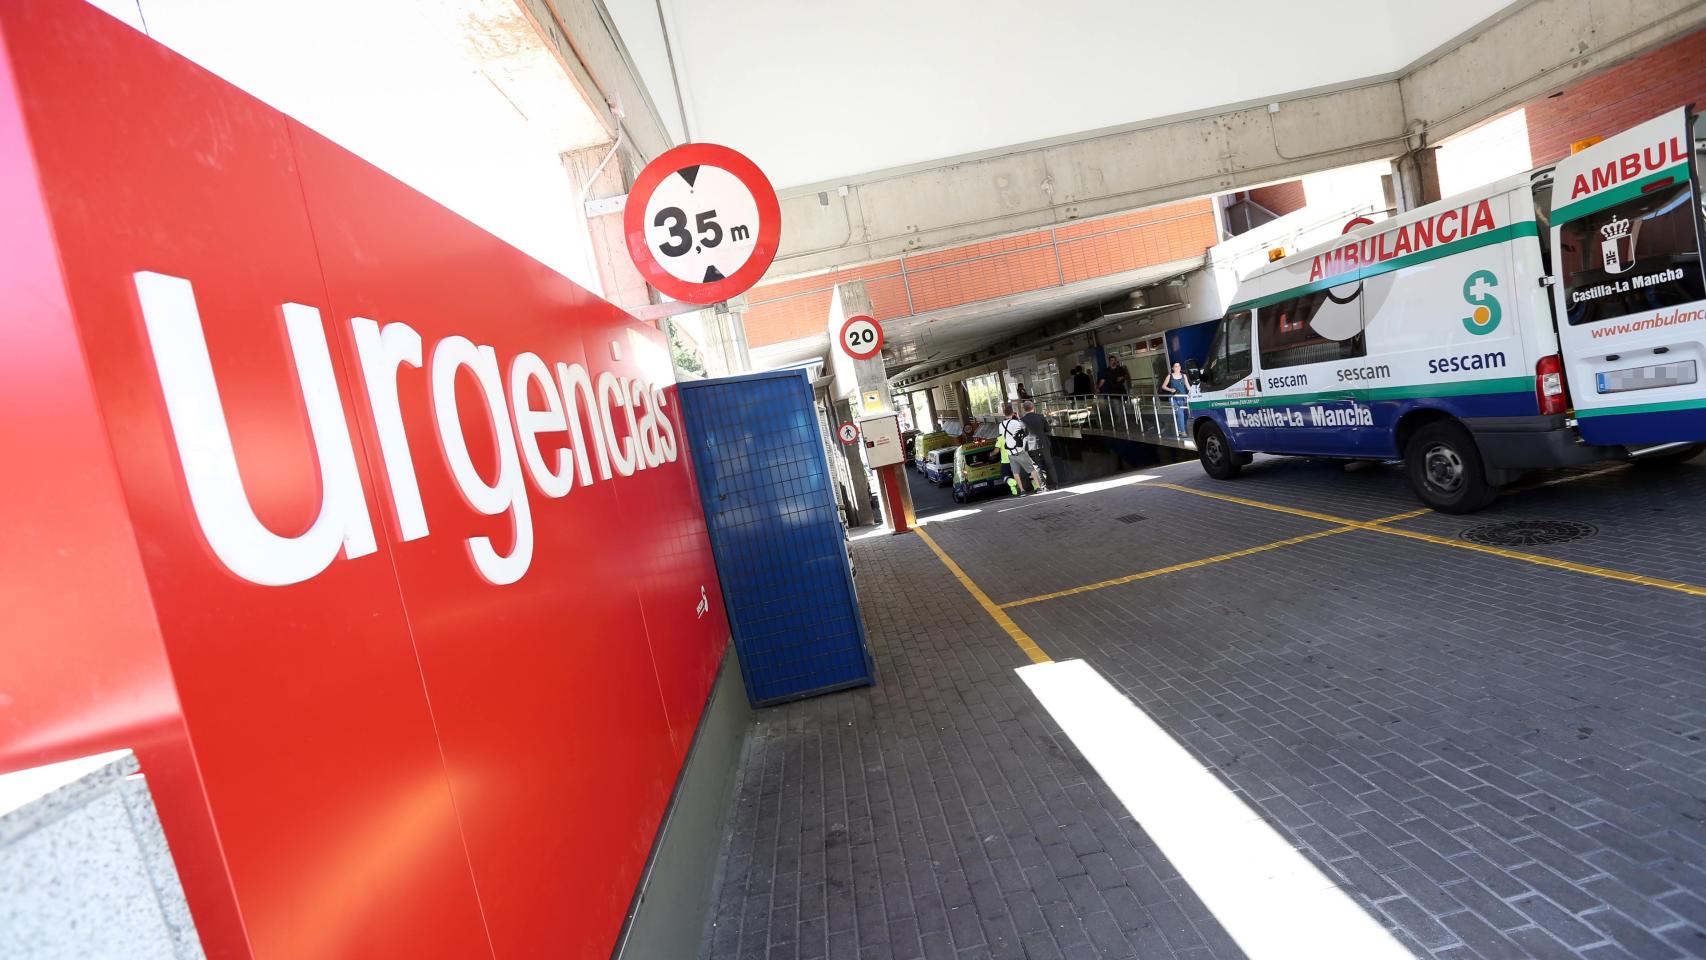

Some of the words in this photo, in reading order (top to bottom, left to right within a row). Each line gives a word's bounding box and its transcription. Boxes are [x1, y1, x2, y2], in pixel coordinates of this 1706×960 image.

[731, 224, 750, 242] m
[1309, 199, 1496, 282] AMBULANCIA
[1572, 281, 1630, 303] Castilla-La
[1632, 267, 1684, 288] Mancha
[1591, 309, 1706, 338] www.ambulanc
[849, 328, 874, 347] 20
[1337, 363, 1391, 382] sescam
[1428, 351, 1506, 373] sescam
[1268, 373, 1308, 389] sescam
[1238, 407, 1304, 428] Castilla-La
[1310, 403, 1374, 427] Mancha
[133, 270, 678, 586] urgencias
